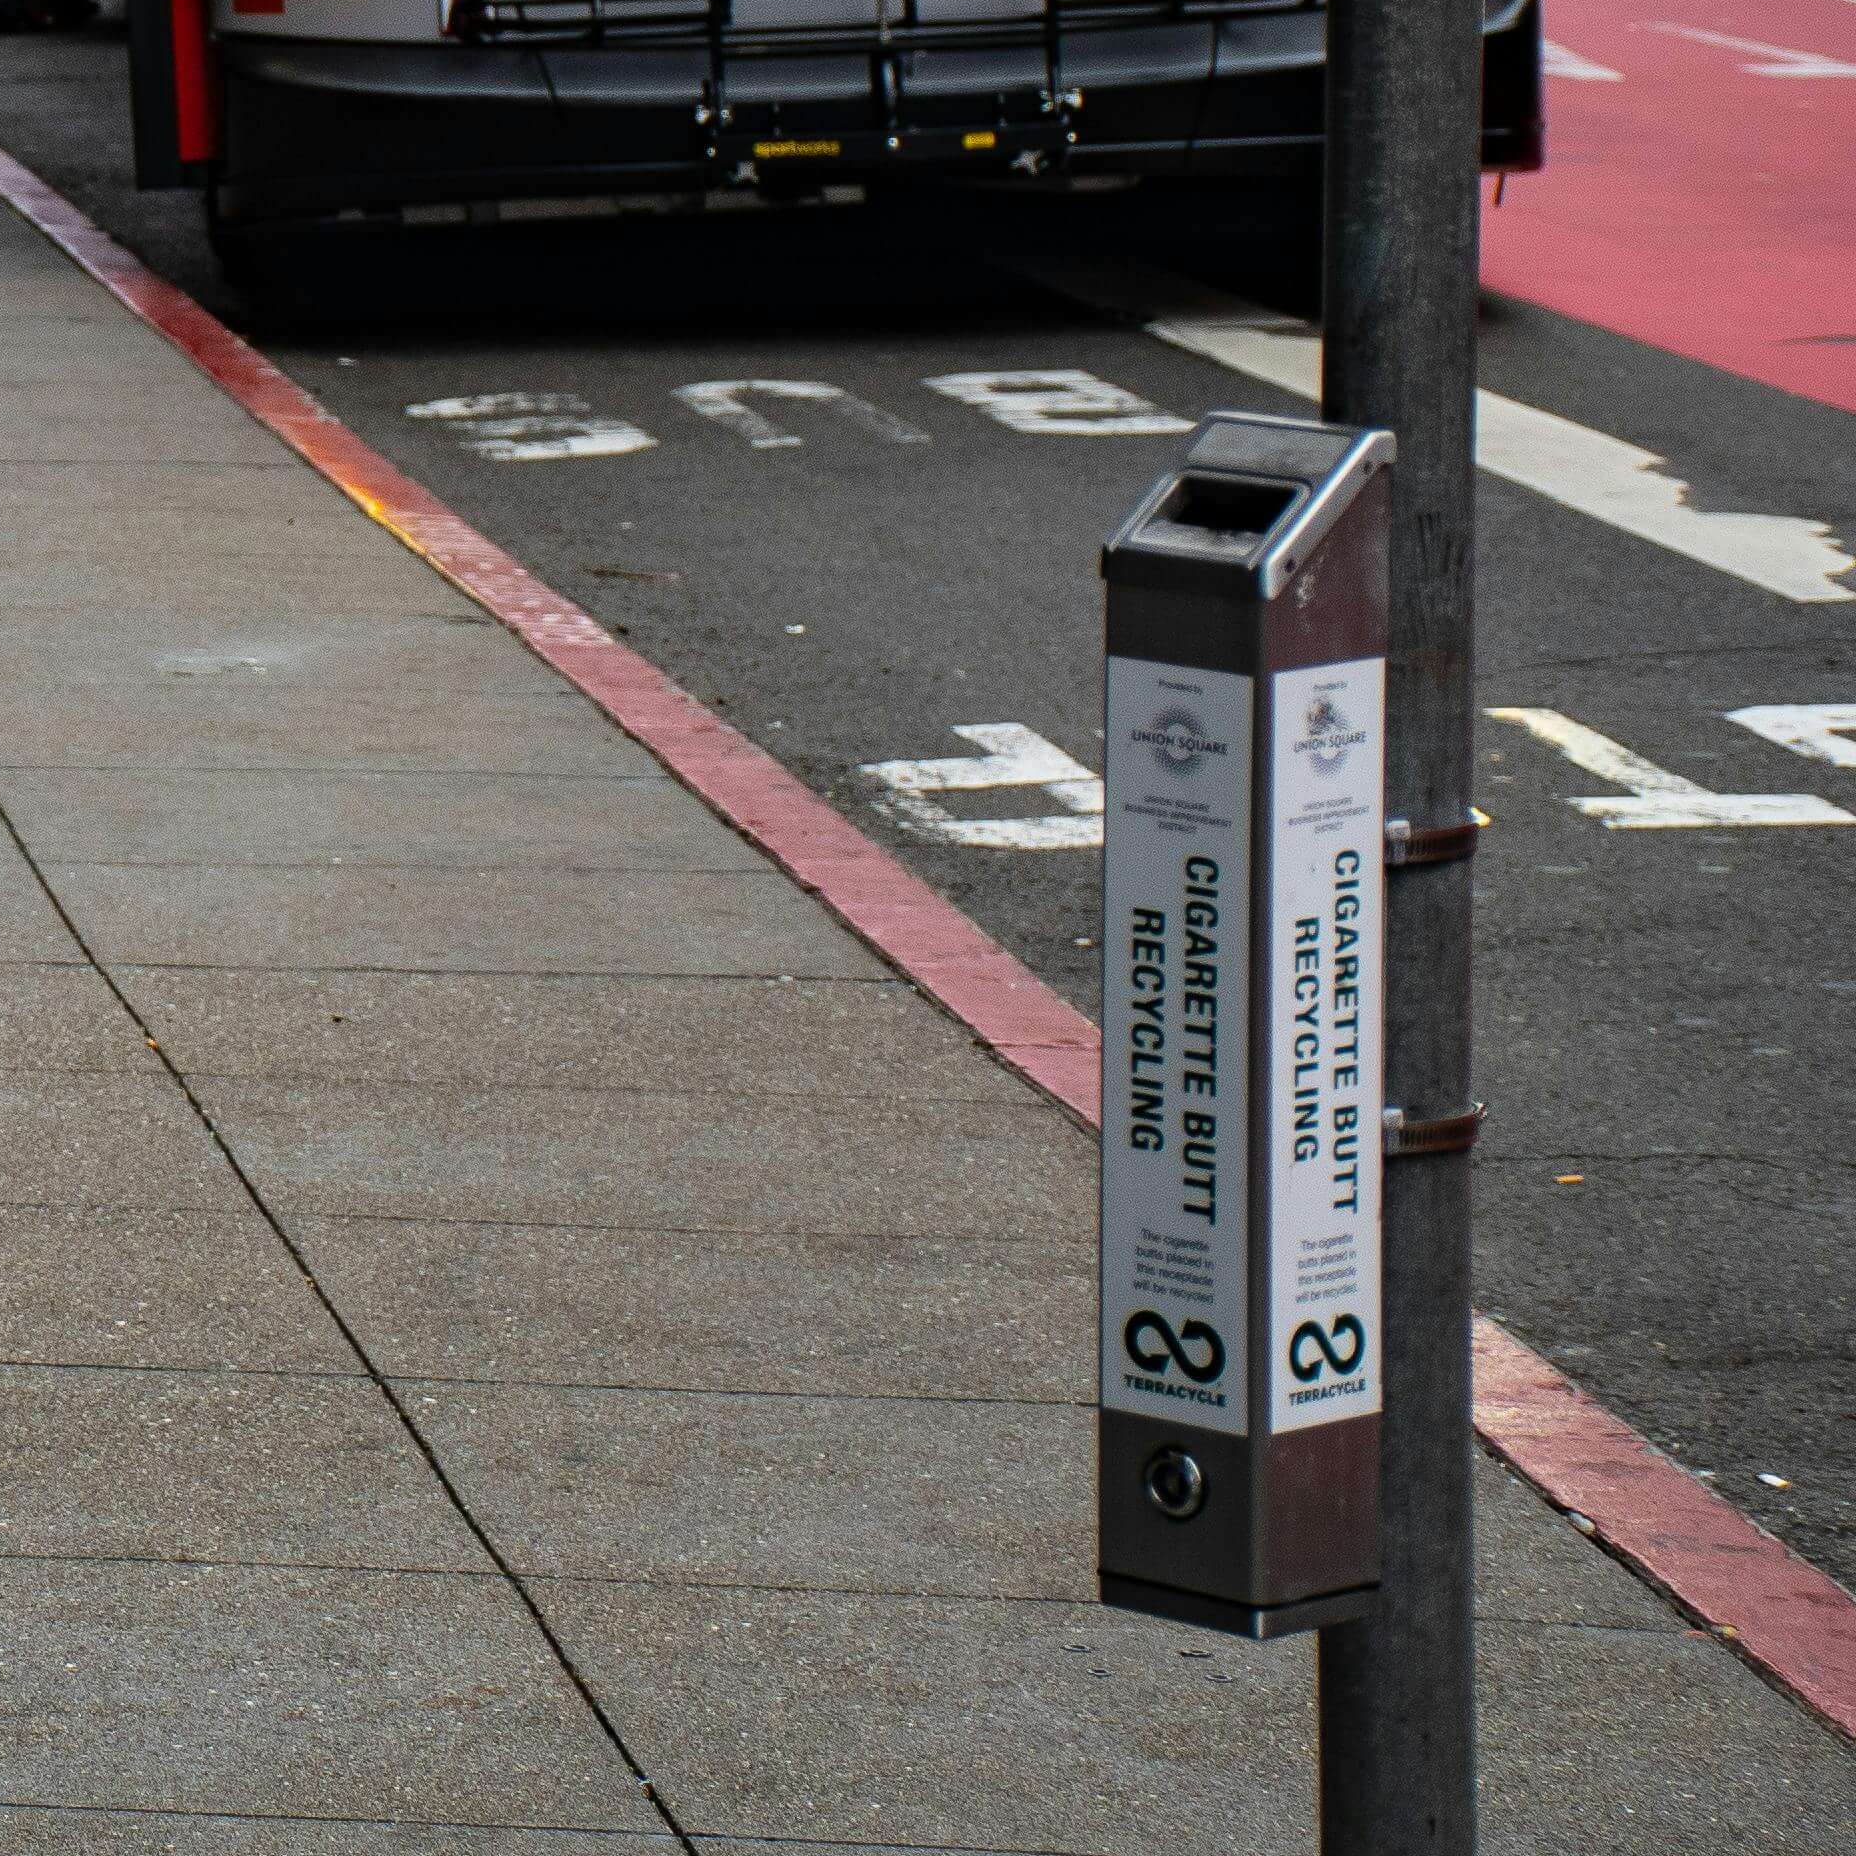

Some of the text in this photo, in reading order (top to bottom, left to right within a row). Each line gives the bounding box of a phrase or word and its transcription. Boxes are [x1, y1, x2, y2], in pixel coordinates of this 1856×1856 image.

[1131, 728, 1228, 756] UNION SQUARE
[1293, 730, 1367, 754] UNION SQUARE
[1130, 906, 1166, 1153] RECYCLING
[1182, 854, 1219, 1225] CIGARETTE BUTT
[1293, 915, 1321, 1162] RECYCLING
[1331, 848, 1362, 1215] CIGARETTE BUTT
[1124, 1373, 1227, 1408] TERRACYCLE
[1289, 1377, 1366, 1407] TERRACYCLE
